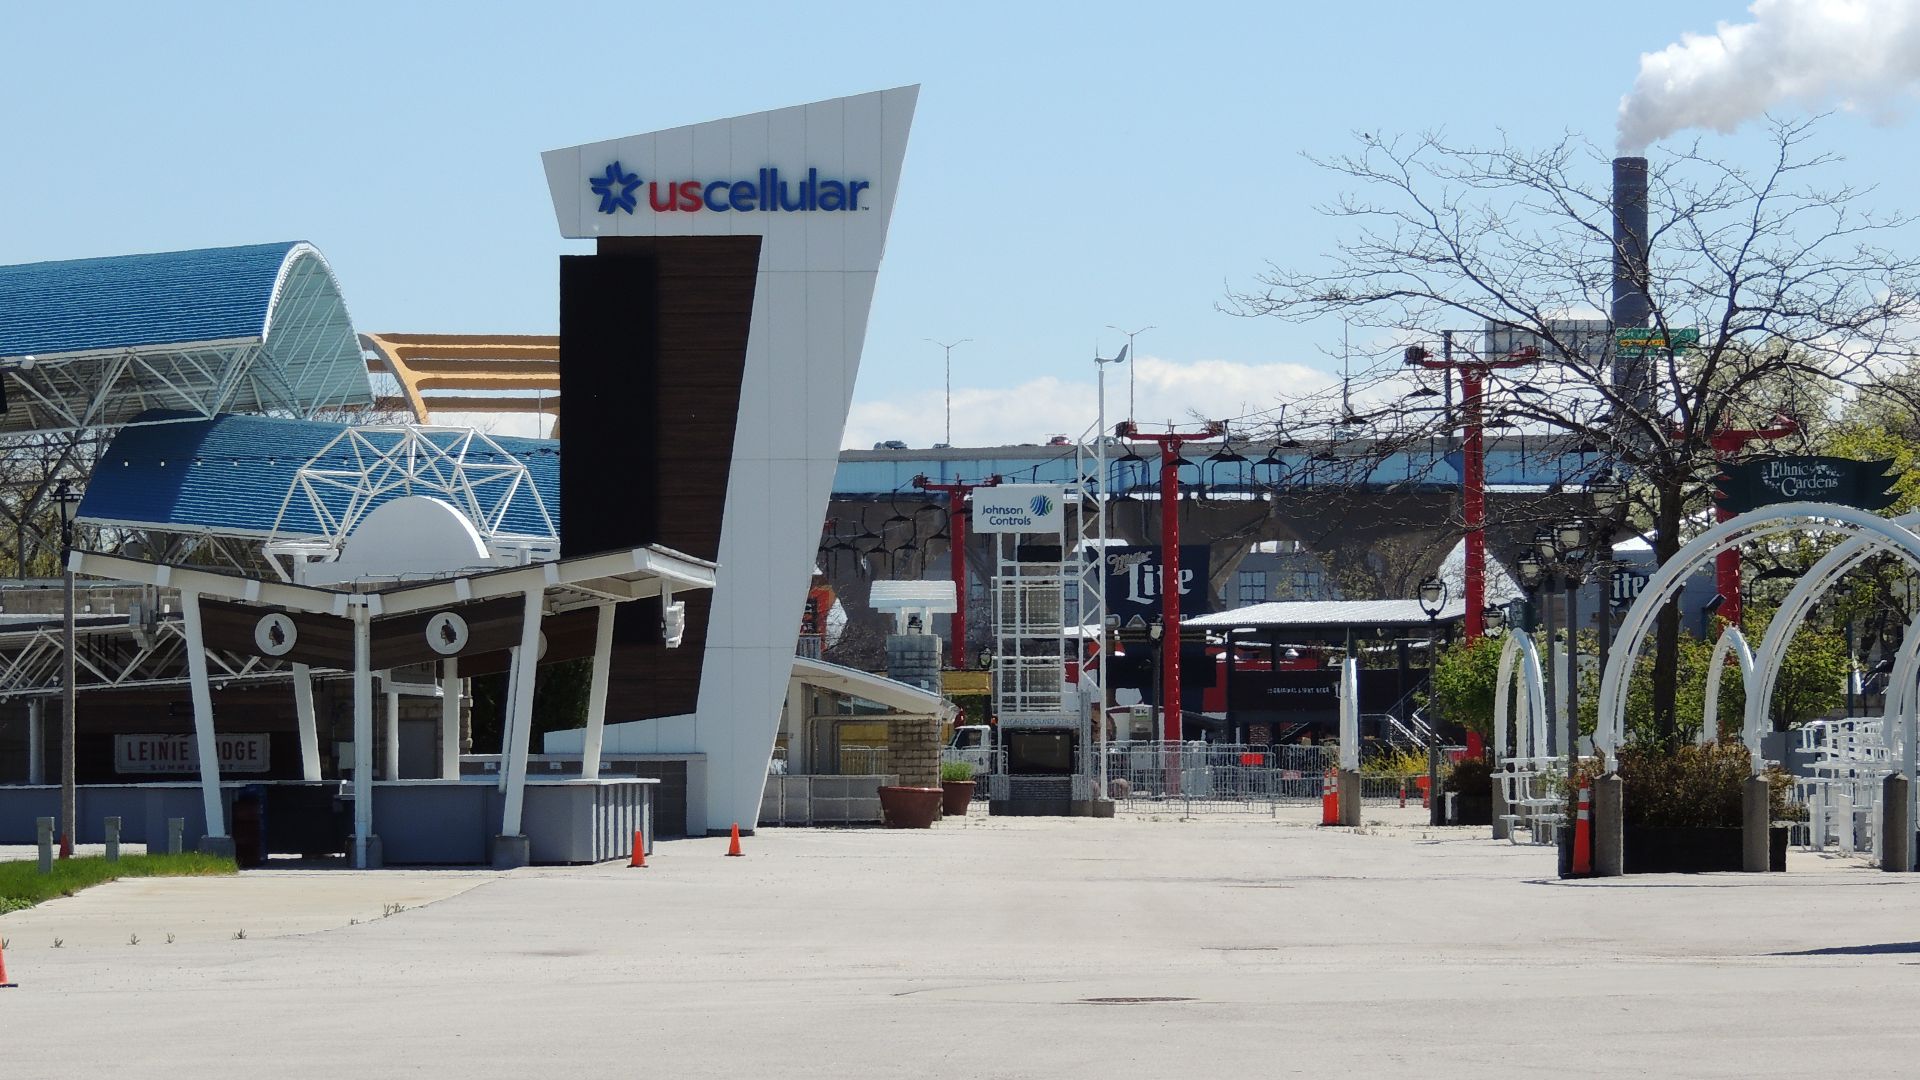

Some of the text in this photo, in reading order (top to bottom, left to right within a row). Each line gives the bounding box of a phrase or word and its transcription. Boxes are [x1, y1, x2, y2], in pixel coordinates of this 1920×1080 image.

[649, 167, 869, 212] uscellular
[1769, 461, 1808, 478] Ethnic
[1781, 474, 1838, 497] Gardens
[982, 504, 1024, 516] Johnson
[989, 515, 1032, 526] Controls
[1609, 572, 1645, 606] ite
[127, 740, 189, 761] LEINIE
